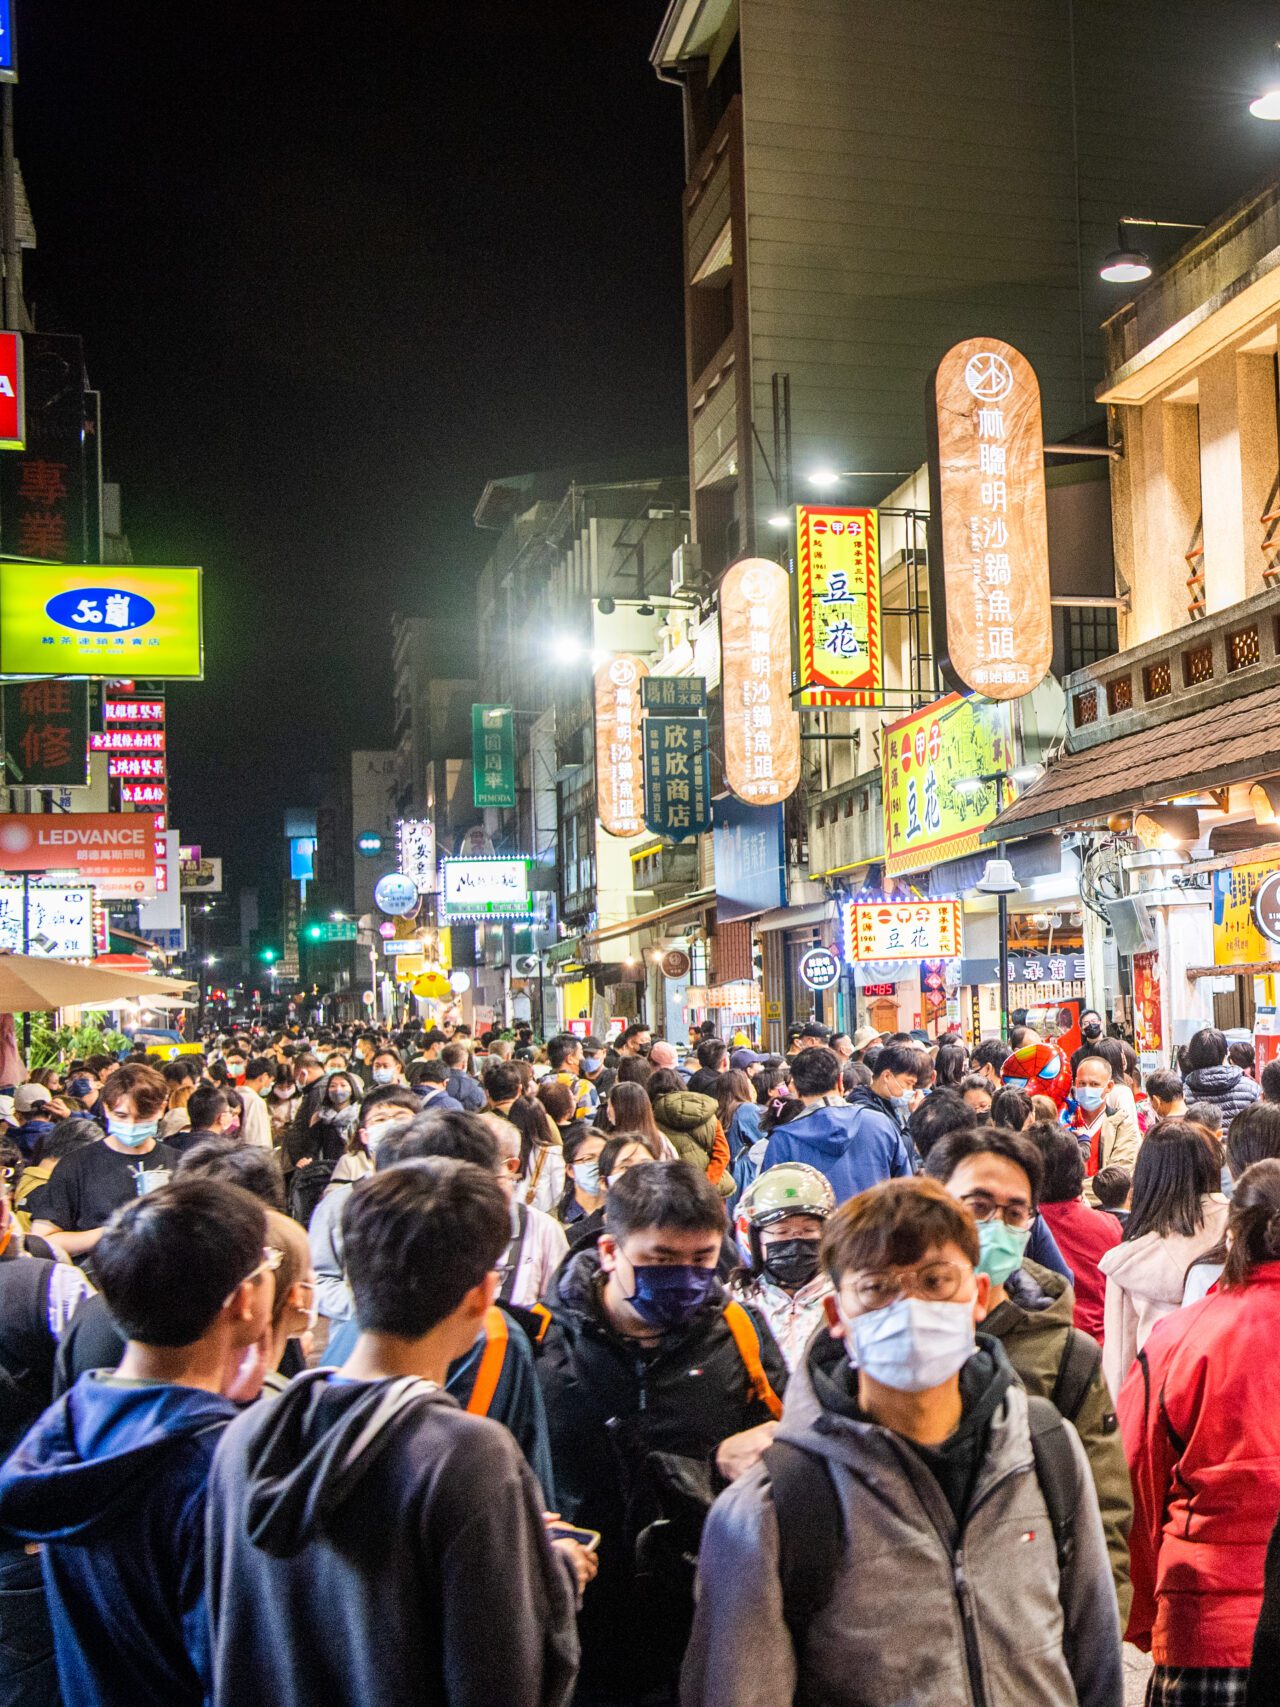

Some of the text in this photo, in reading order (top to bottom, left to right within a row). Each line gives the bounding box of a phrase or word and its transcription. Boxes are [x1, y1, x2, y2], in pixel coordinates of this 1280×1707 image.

[813, 520, 862, 536] 一甲子
[978, 407, 1015, 660] 林聰明沙鍋魚頭
[71, 594, 131, 628] 50嵐
[823, 573, 858, 654] 豆花
[664, 725, 690, 828] 欣欣商店
[907, 769, 940, 839] 豆花
[38, 829, 145, 845] LEDVANCE
[885, 926, 929, 950] 豆花
[865, 985, 893, 995] 0485
